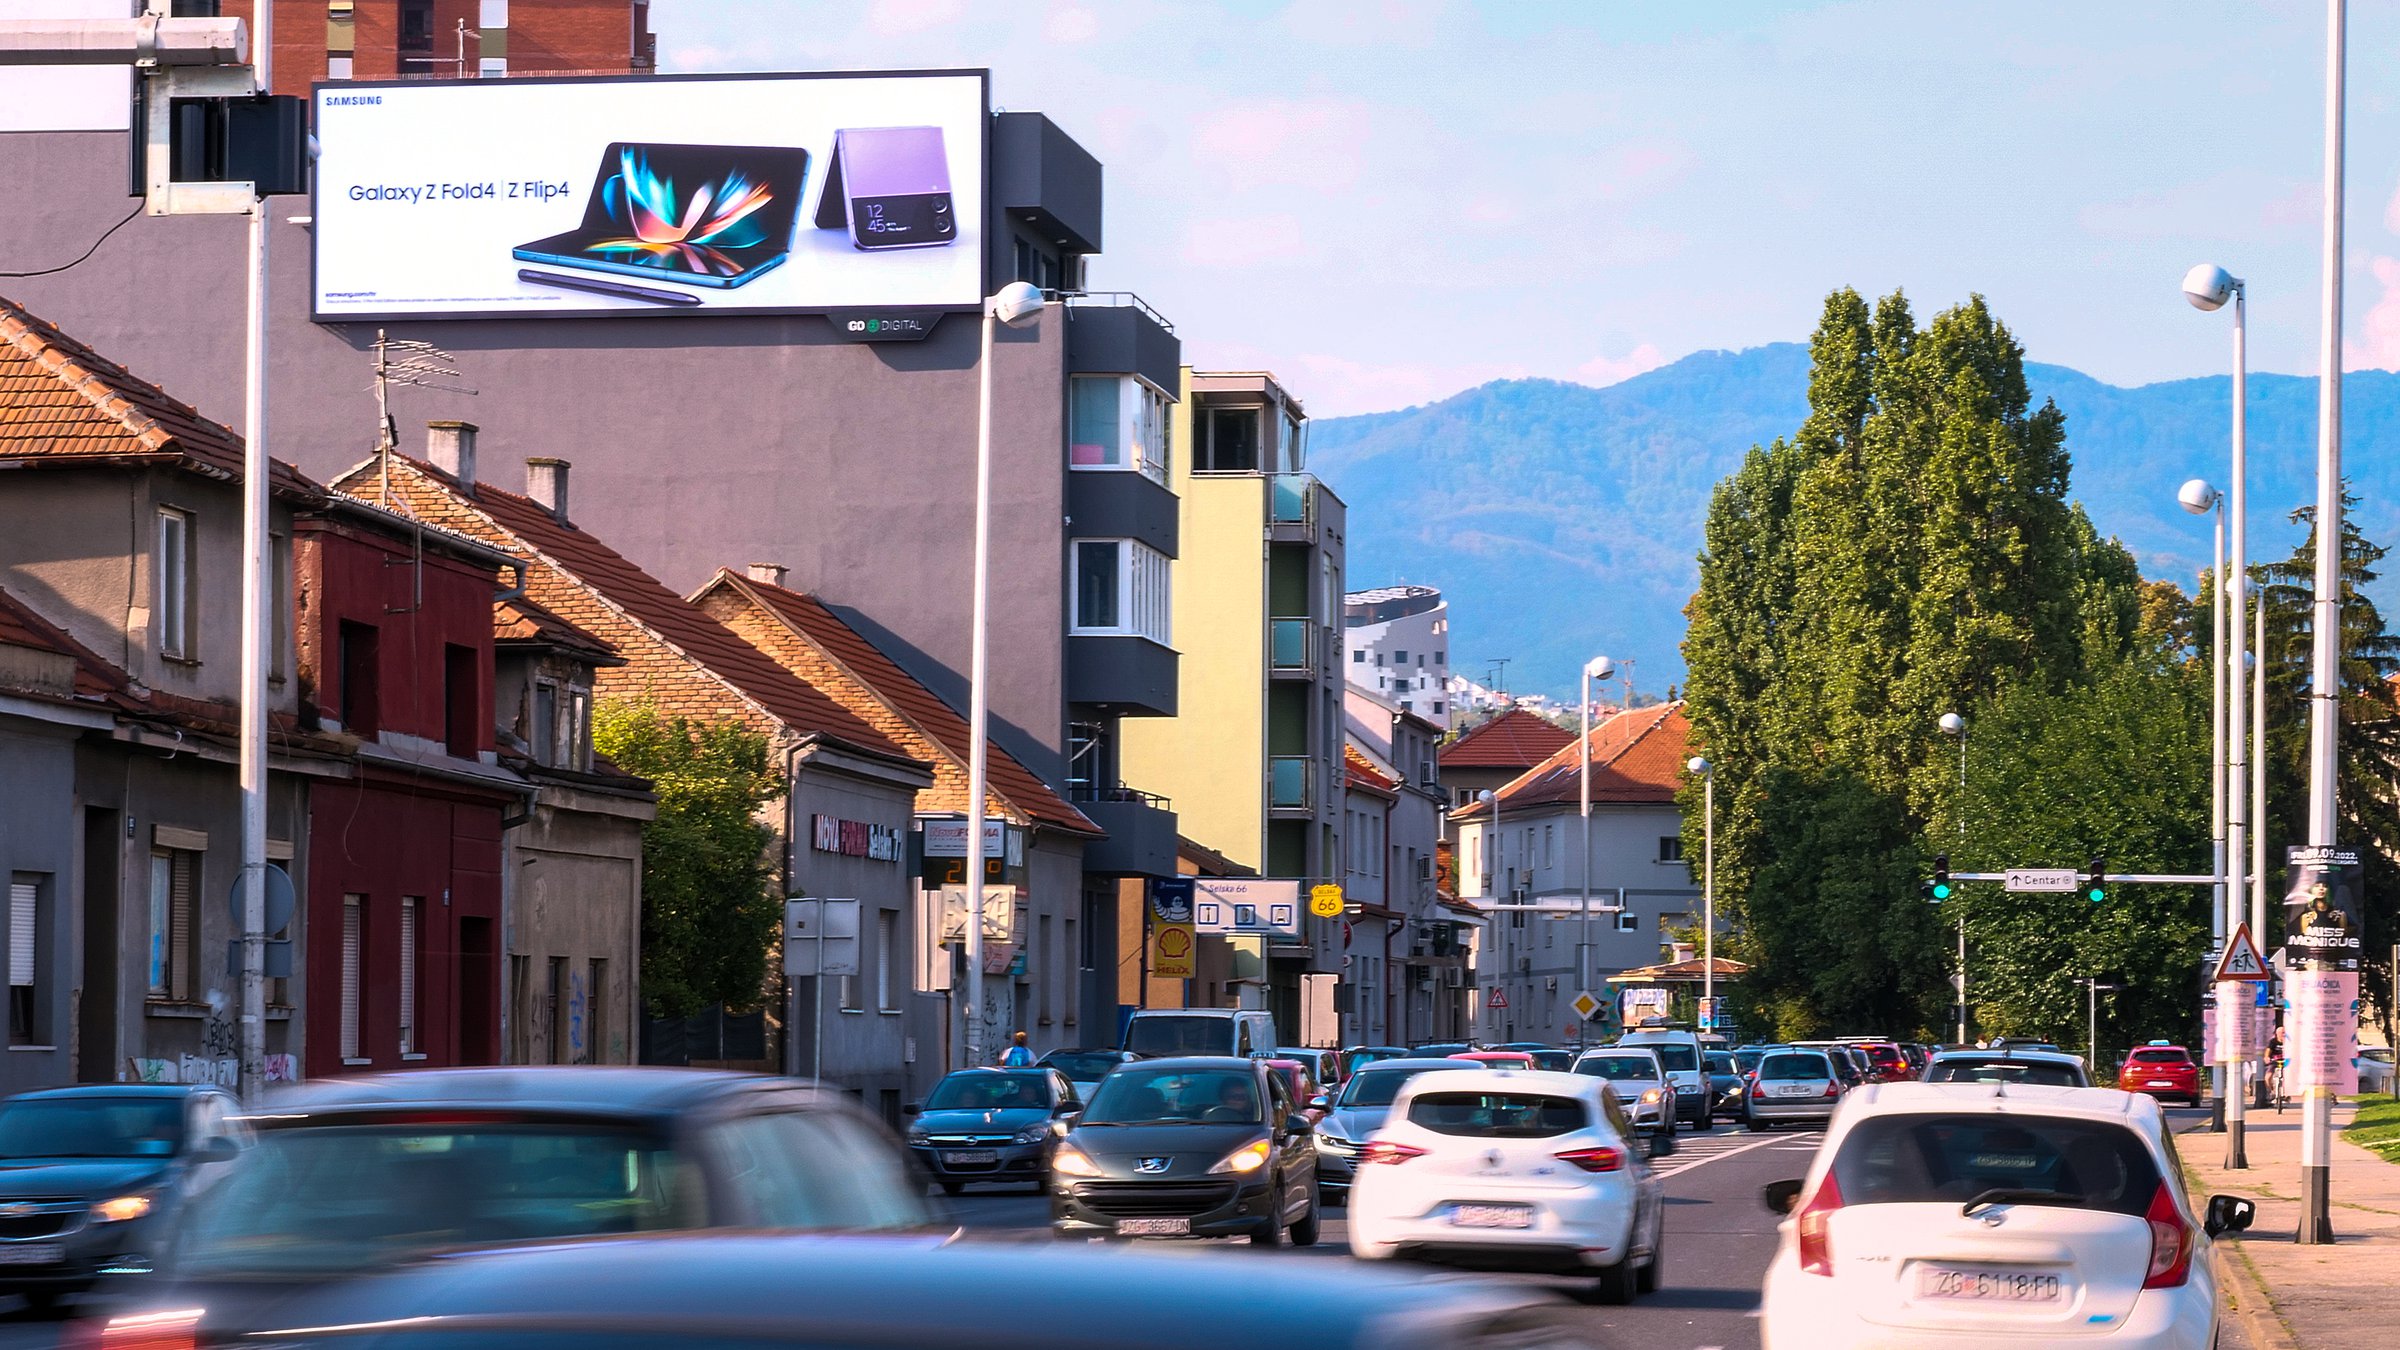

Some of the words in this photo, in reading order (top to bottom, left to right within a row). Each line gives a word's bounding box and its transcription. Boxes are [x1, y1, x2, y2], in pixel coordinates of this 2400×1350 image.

[326, 96, 383, 106] SAMSUNG
[349, 185, 422, 205] Galaxy
[425, 184, 437, 200] Z
[441, 182, 496, 200] Fold4
[508, 182, 519, 198] Z
[524, 180, 570, 204] Flip4
[865, 204, 884, 218] 12
[867, 218, 886, 233] 45
[881, 320, 923, 331] DIGITAL
[815, 814, 840, 853] NOVA
[2024, 875, 2061, 885] Centar
[1208, 884, 1234, 893] Selska
[1235, 884, 1248, 893] 66
[1318, 899, 1337, 911] 66
[2305, 926, 2346, 937] MISS
[2287, 935, 2360, 948] MONIQUE
[1156, 966, 1189, 975] HELIX
[1936, 1272, 1964, 1294] ZG
